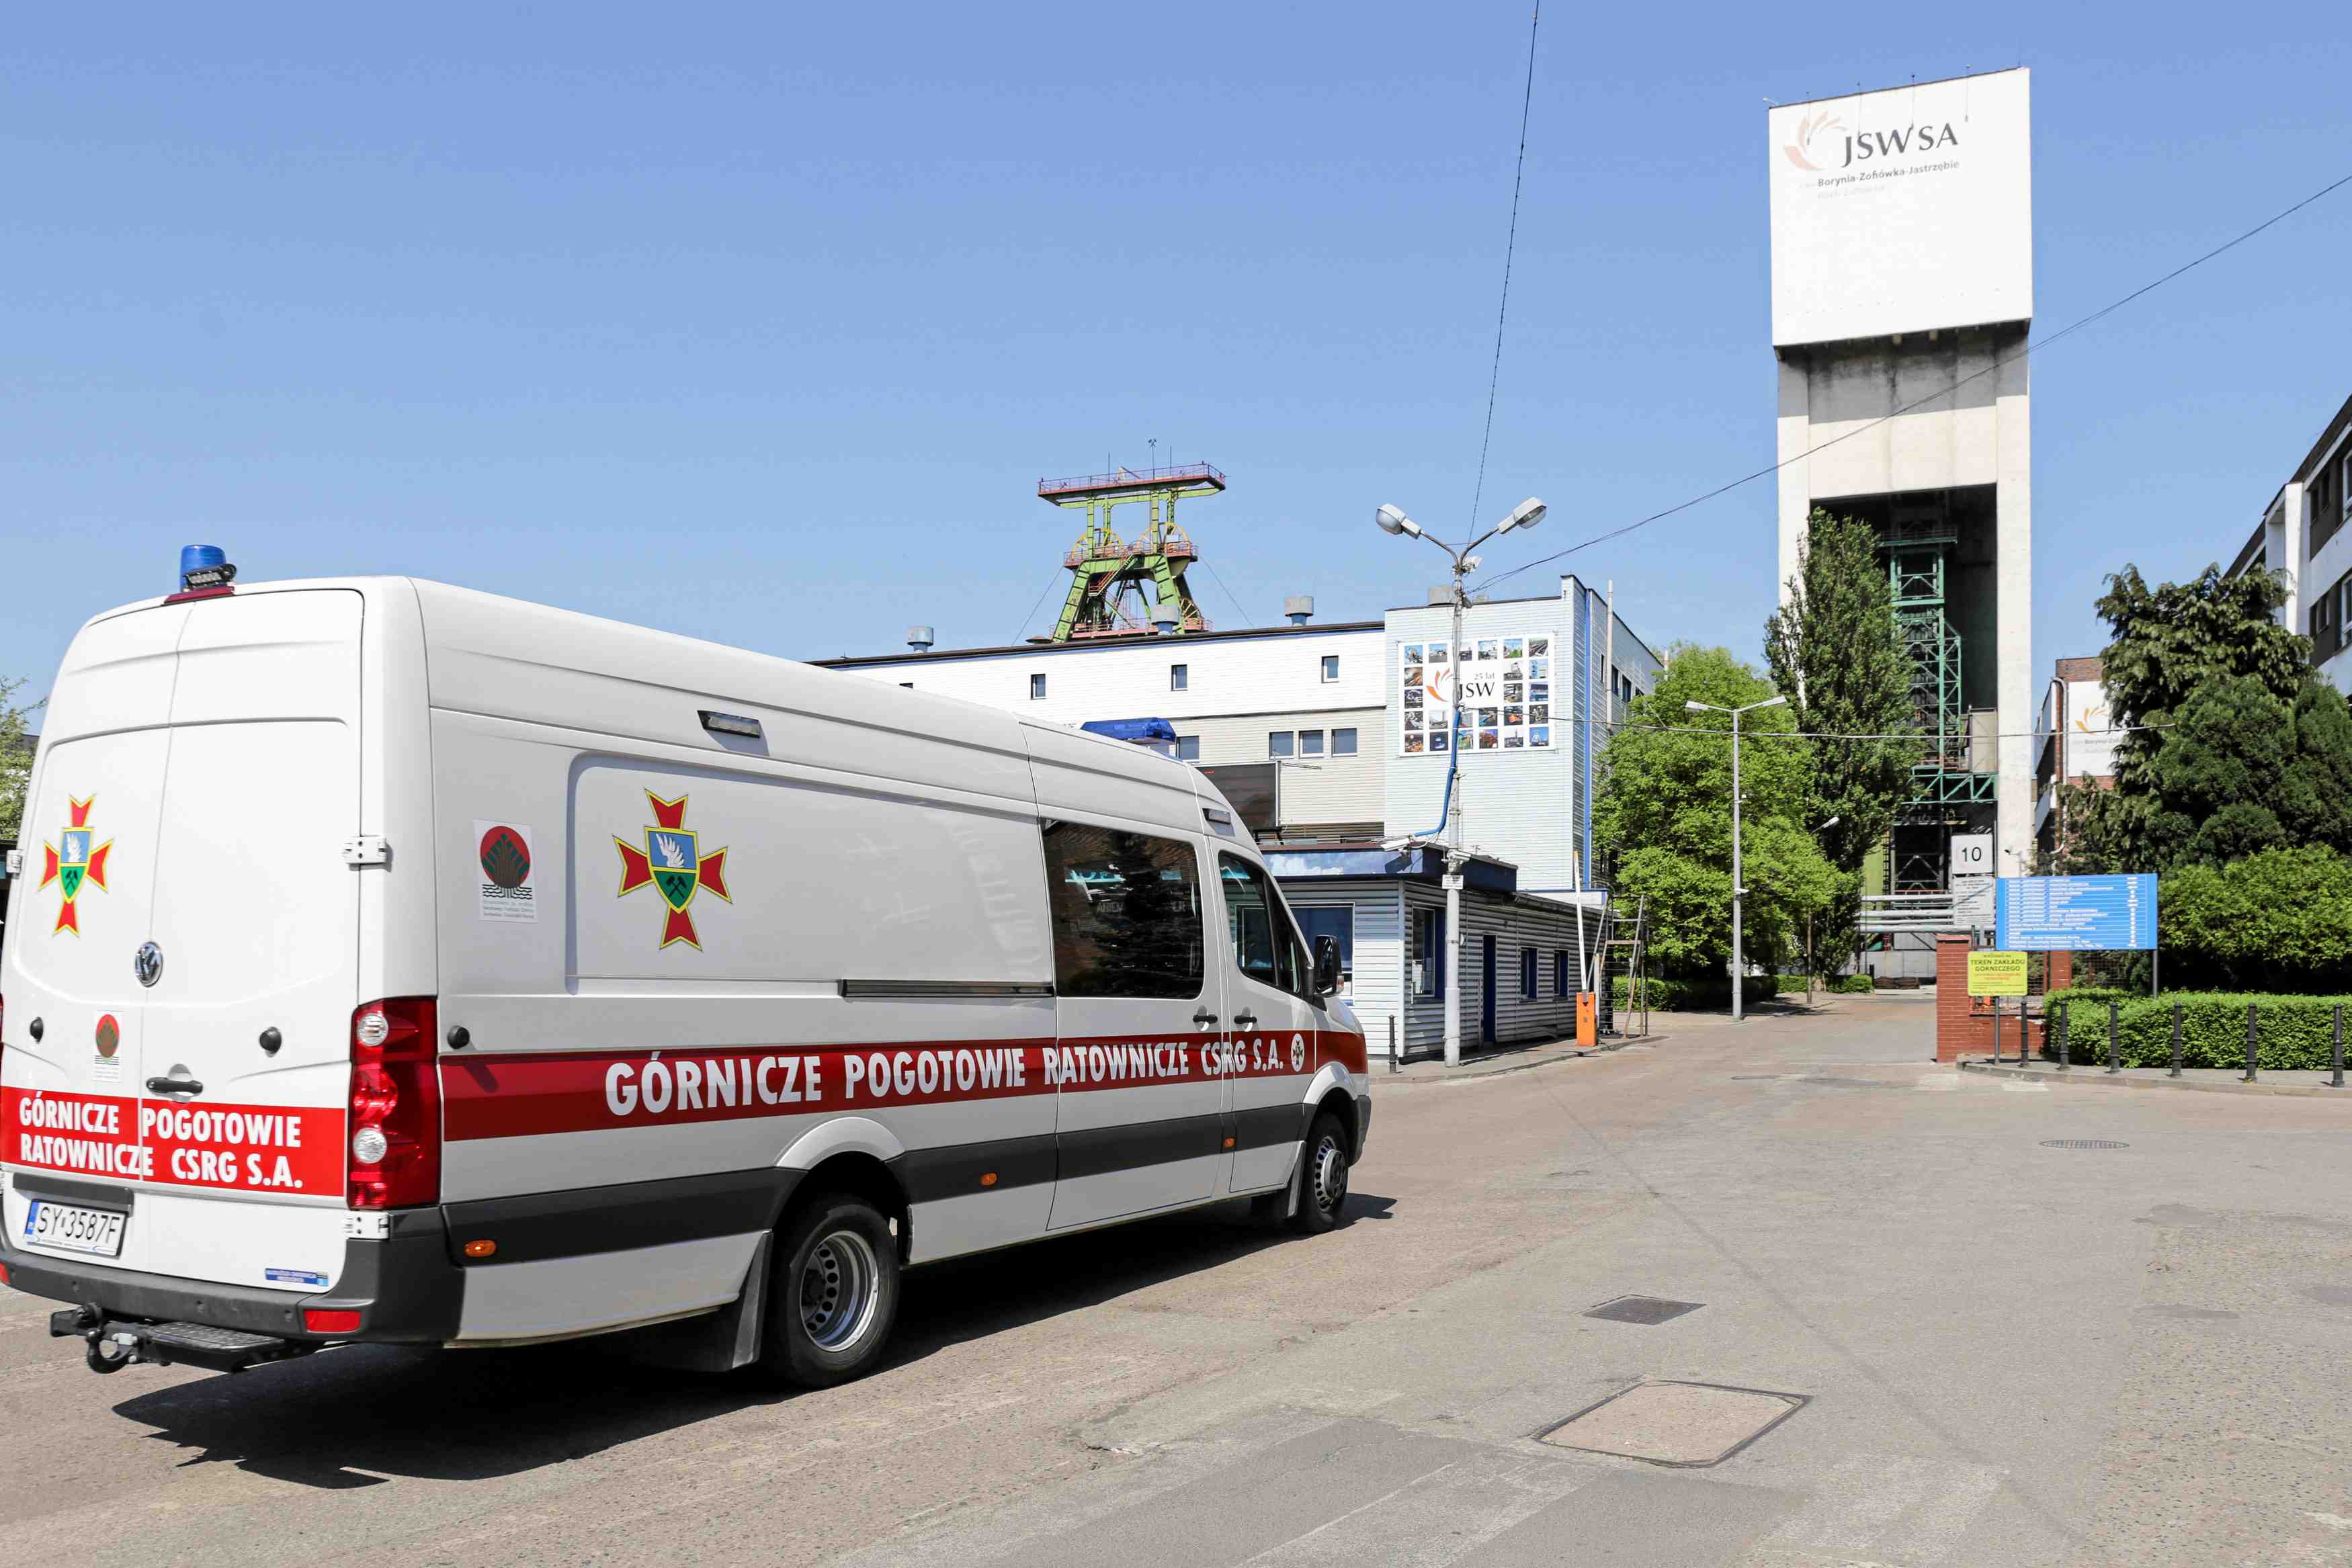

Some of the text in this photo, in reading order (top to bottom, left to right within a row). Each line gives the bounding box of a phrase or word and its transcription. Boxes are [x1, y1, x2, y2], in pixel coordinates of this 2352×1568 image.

[1841, 122, 1958, 167] JSW SA
[1458, 681, 1495, 701] JSW
[1962, 846, 1982, 862] 10
[605, 1039, 1284, 1116] GÓRNICZE POGOTOWIE RATOWNICZE CSRG S.A.
[19, 1091, 301, 1147] GÓRNICZE POGOTOWIE
[21, 1133, 303, 1188] RATOWNICZE CSRG S.A.
[38, 1207, 120, 1243] SY 3587F
